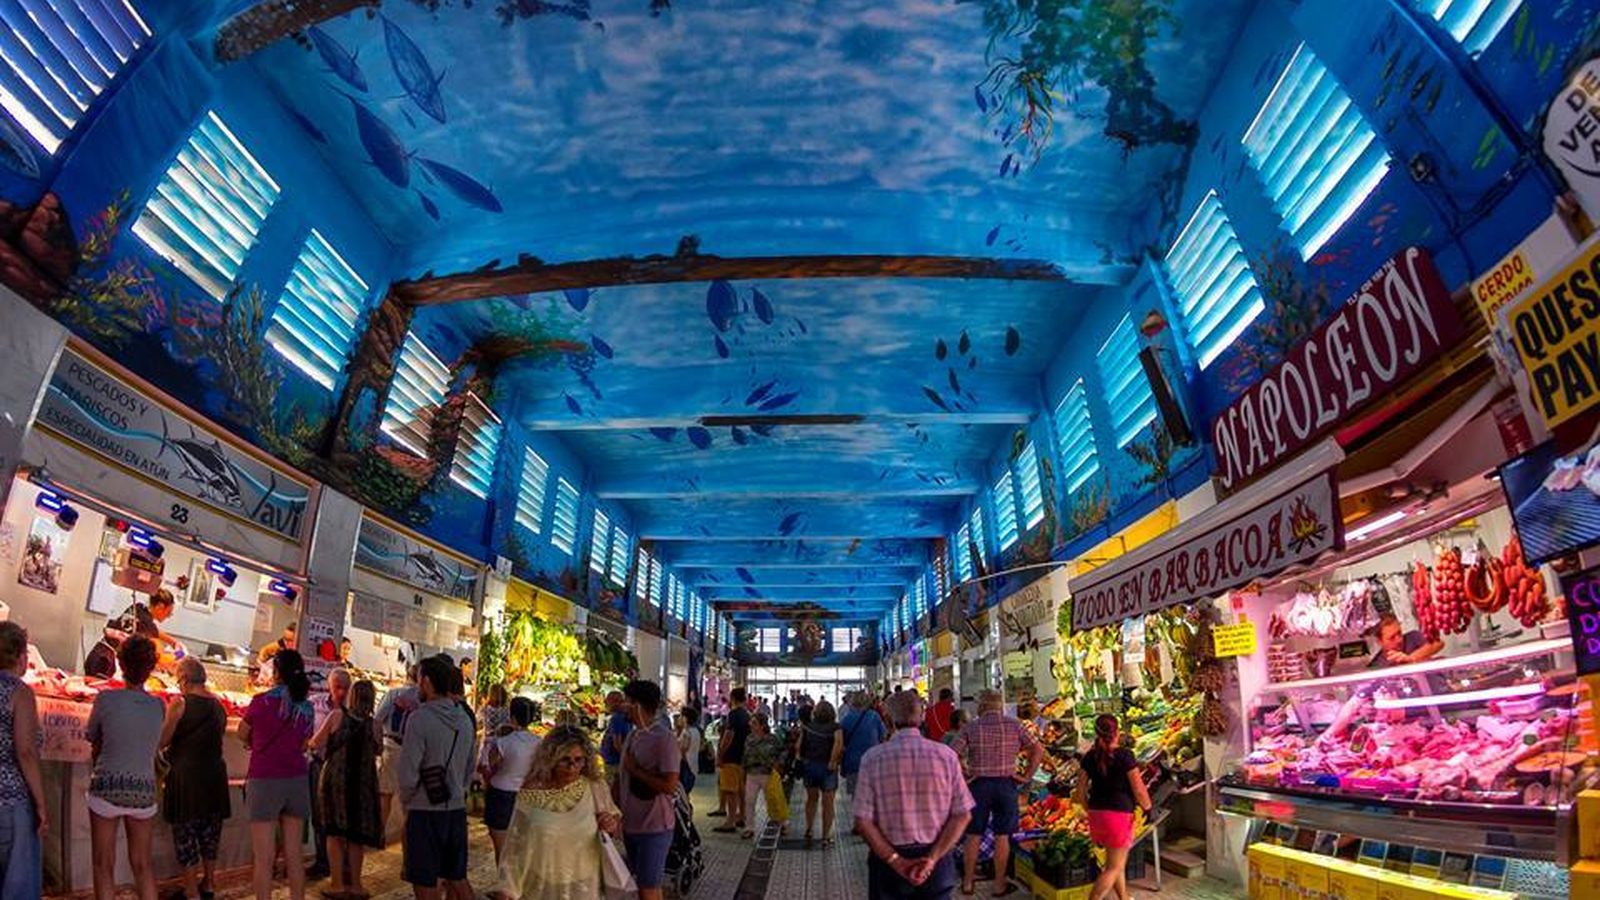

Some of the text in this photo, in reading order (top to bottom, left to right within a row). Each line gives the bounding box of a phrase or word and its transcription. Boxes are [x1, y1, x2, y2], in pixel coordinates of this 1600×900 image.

[1478, 255, 1524, 302] CERDO
[61, 382, 129, 430] MARISCOS
[68, 362, 149, 417] PESCADOS Y
[46, 406, 124, 457] ESPECIALIDAD
[125, 449, 139, 466] EN
[170, 503, 190, 525] 23
[1075, 589, 1117, 626] TODO
[1117, 570, 1145, 612] EN
[1147, 507, 1286, 603] BARBACOA
